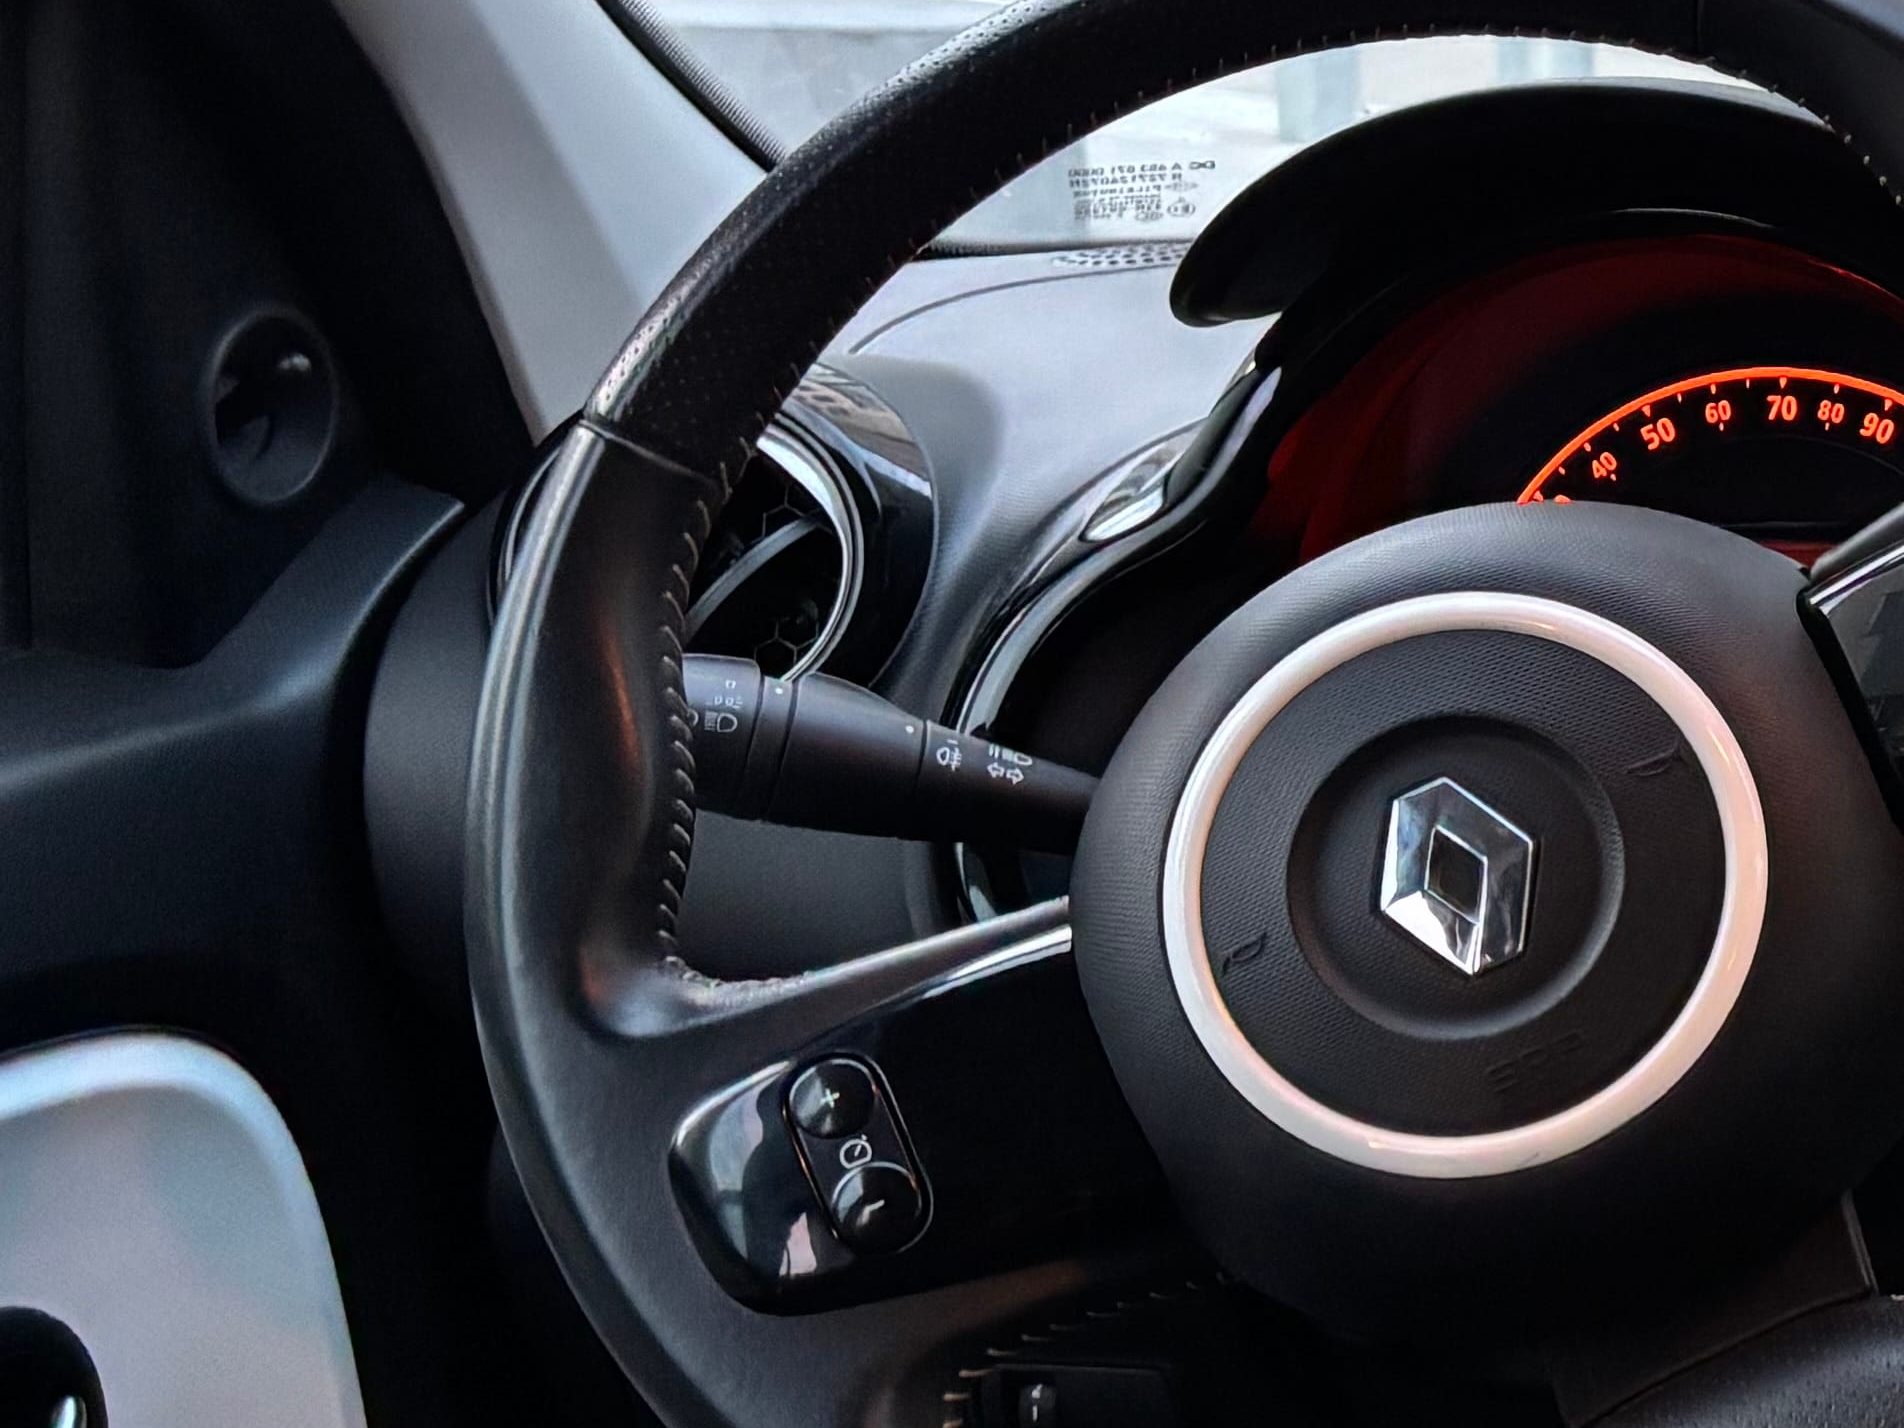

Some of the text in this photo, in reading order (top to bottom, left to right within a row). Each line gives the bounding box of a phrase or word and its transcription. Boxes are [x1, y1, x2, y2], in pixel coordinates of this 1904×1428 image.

[1591, 451, 1618, 479] 40
[1640, 416, 1676, 451] 50
[1705, 399, 1732, 423] 60
[1766, 395, 1798, 421] 70
[1817, 399, 1844, 424] 80
[1859, 412, 1895, 444] 90
